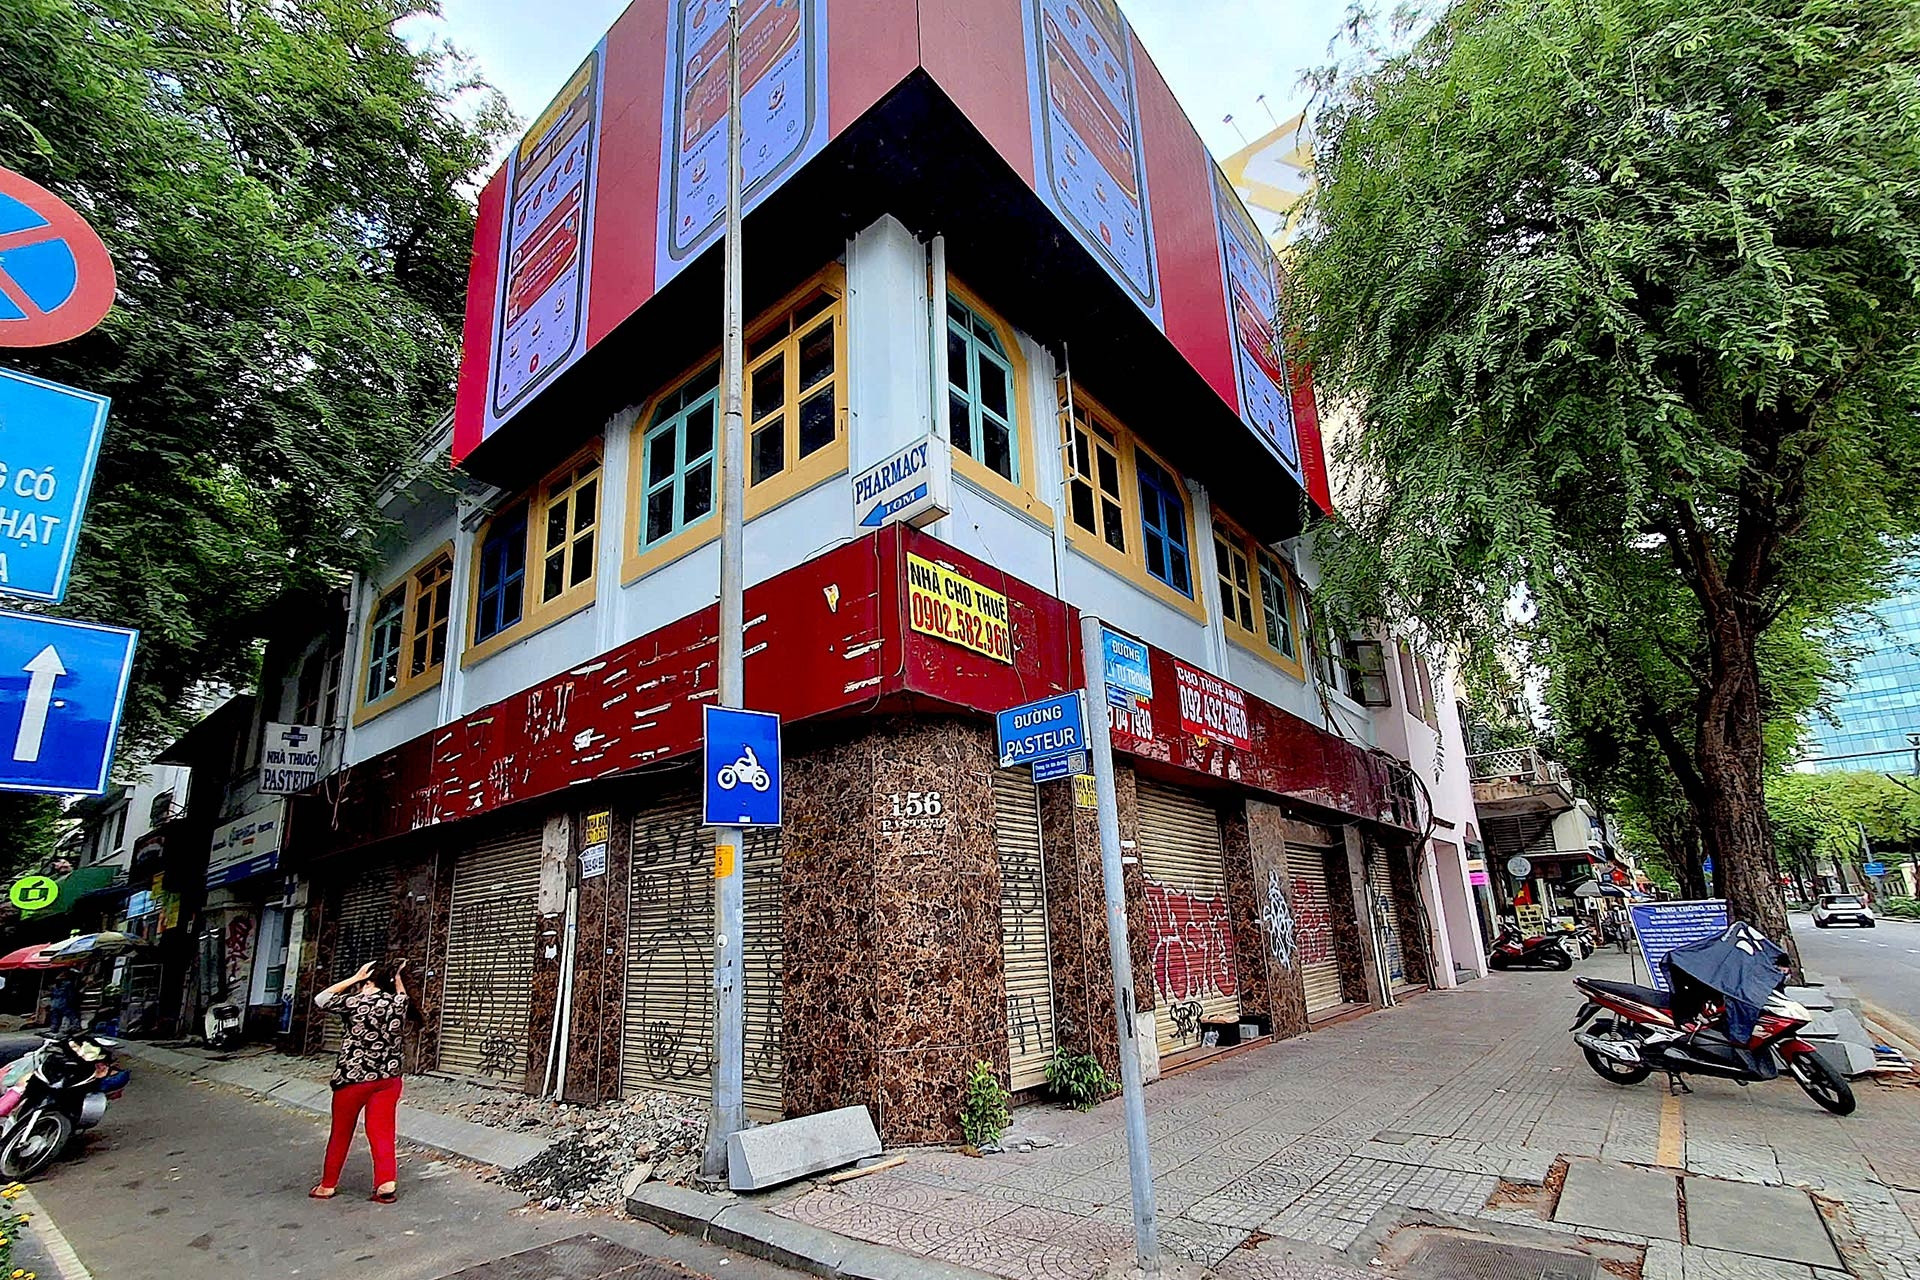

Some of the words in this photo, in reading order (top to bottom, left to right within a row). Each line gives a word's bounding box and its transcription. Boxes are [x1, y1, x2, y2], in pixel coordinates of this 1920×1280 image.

[14, 466, 57, 501] CÓ
[855, 442, 928, 504] PHARMACY
[910, 562, 942, 596] NHÀ
[944, 577, 973, 608] CHO
[975, 590, 1007, 623] THUÊ
[1111, 639, 1140, 662] ĐƯỜNG
[1106, 655, 1115, 678] LÝ
[1176, 667, 1199, 686] CHO
[1199, 677, 1225, 697] THUÊ
[1014, 705, 1062, 729] ĐƯỜNG
[1180, 685, 1203, 724] 092
[1203, 695, 1224, 731] 432
[1223, 702, 1248, 740] 5858
[1006, 727, 1075, 757] PASTEUR
[266, 749, 286, 764] NHÀ
[288, 750, 318, 766] THUỐC
[889, 792, 942, 816] 156
